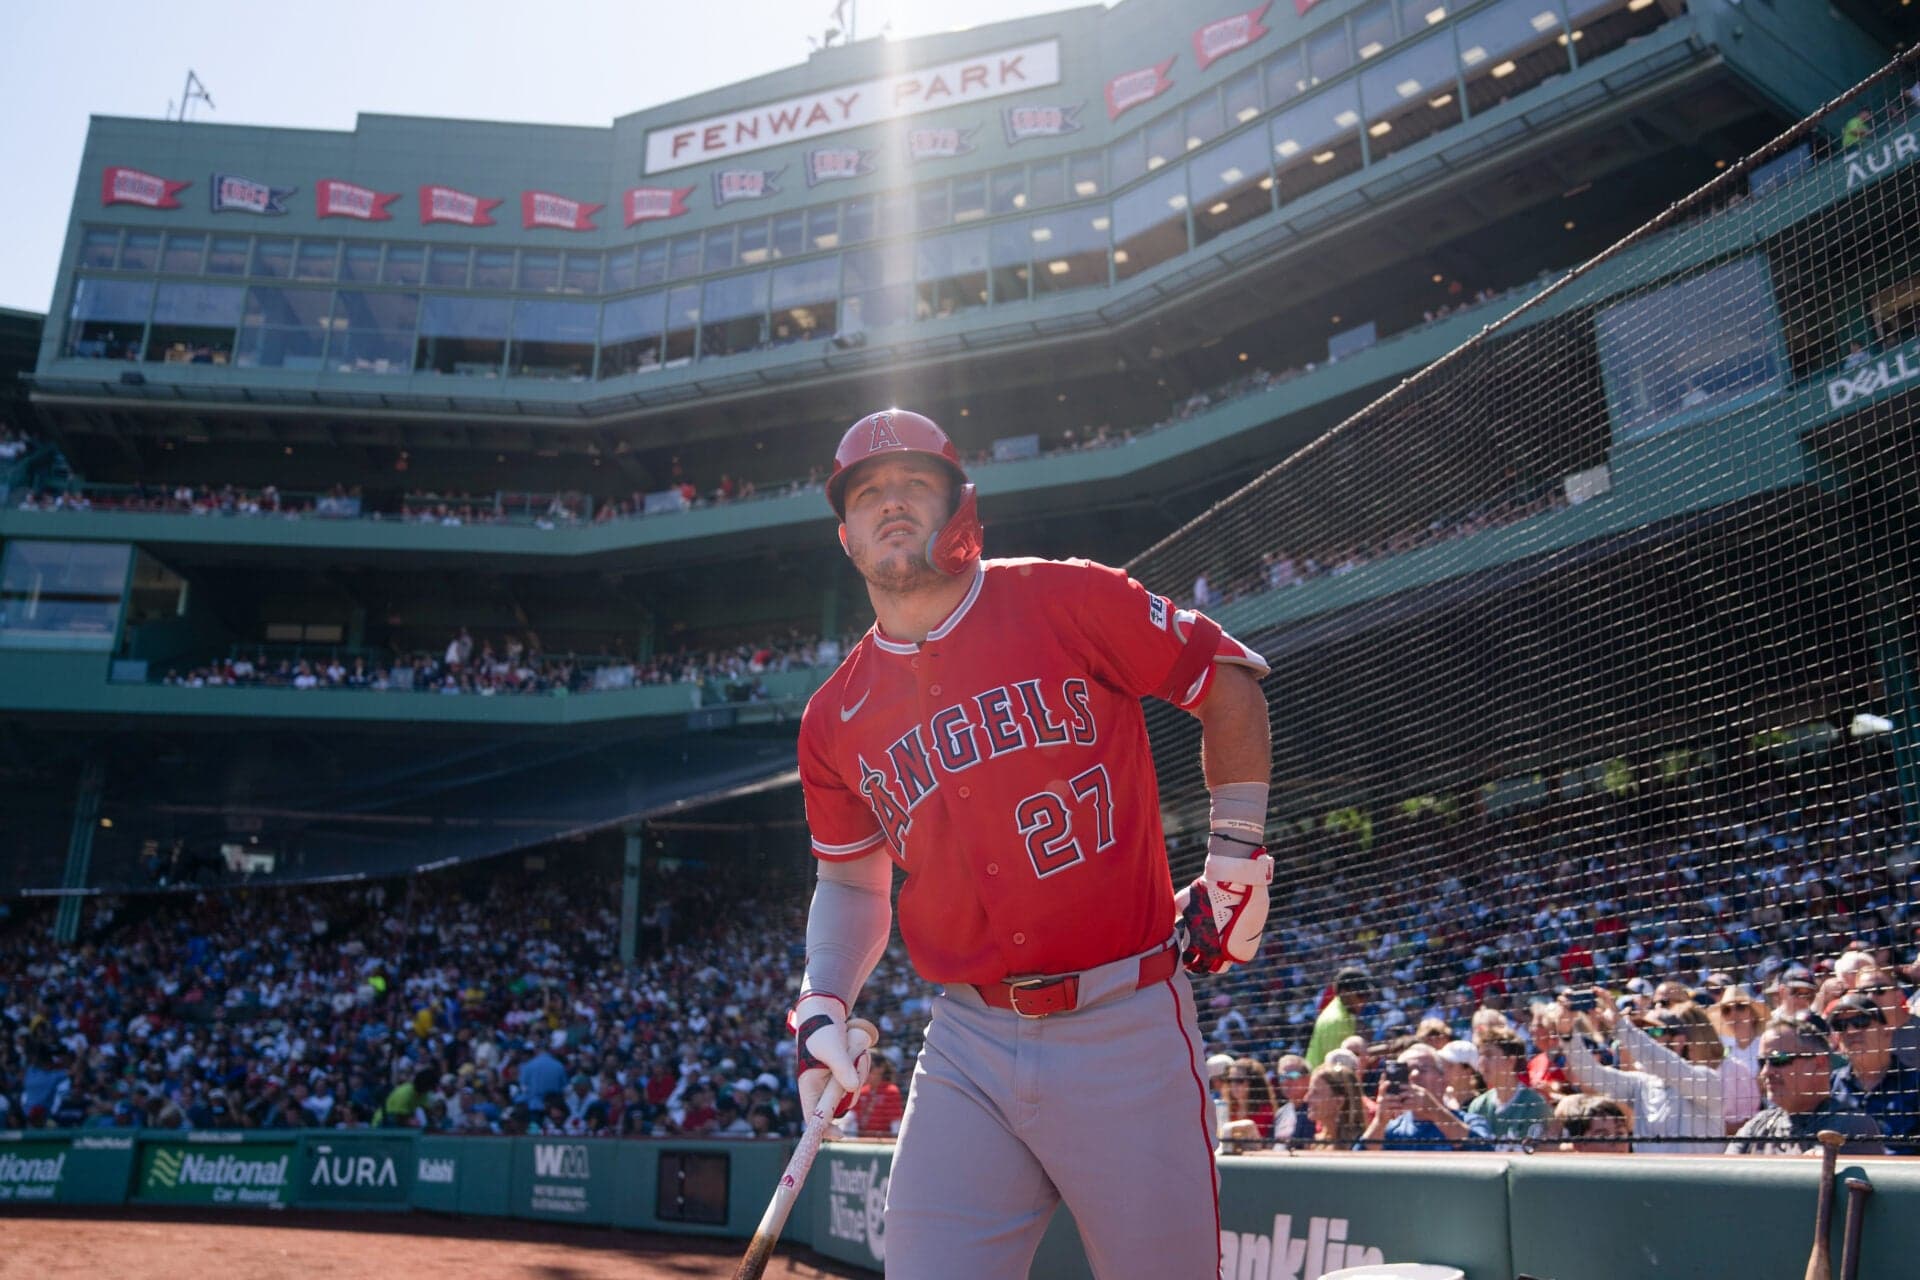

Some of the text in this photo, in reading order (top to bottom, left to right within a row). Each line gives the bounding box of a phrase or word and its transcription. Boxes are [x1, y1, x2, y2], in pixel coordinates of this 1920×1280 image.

[670, 55, 1026, 159] FENWAY PARK
[1827, 351, 1920, 410] DELL
[868, 413, 901, 452] A
[858, 678, 1097, 861] ANGELS
[1015, 763, 1117, 880] 27
[179, 1152, 289, 1186] National
